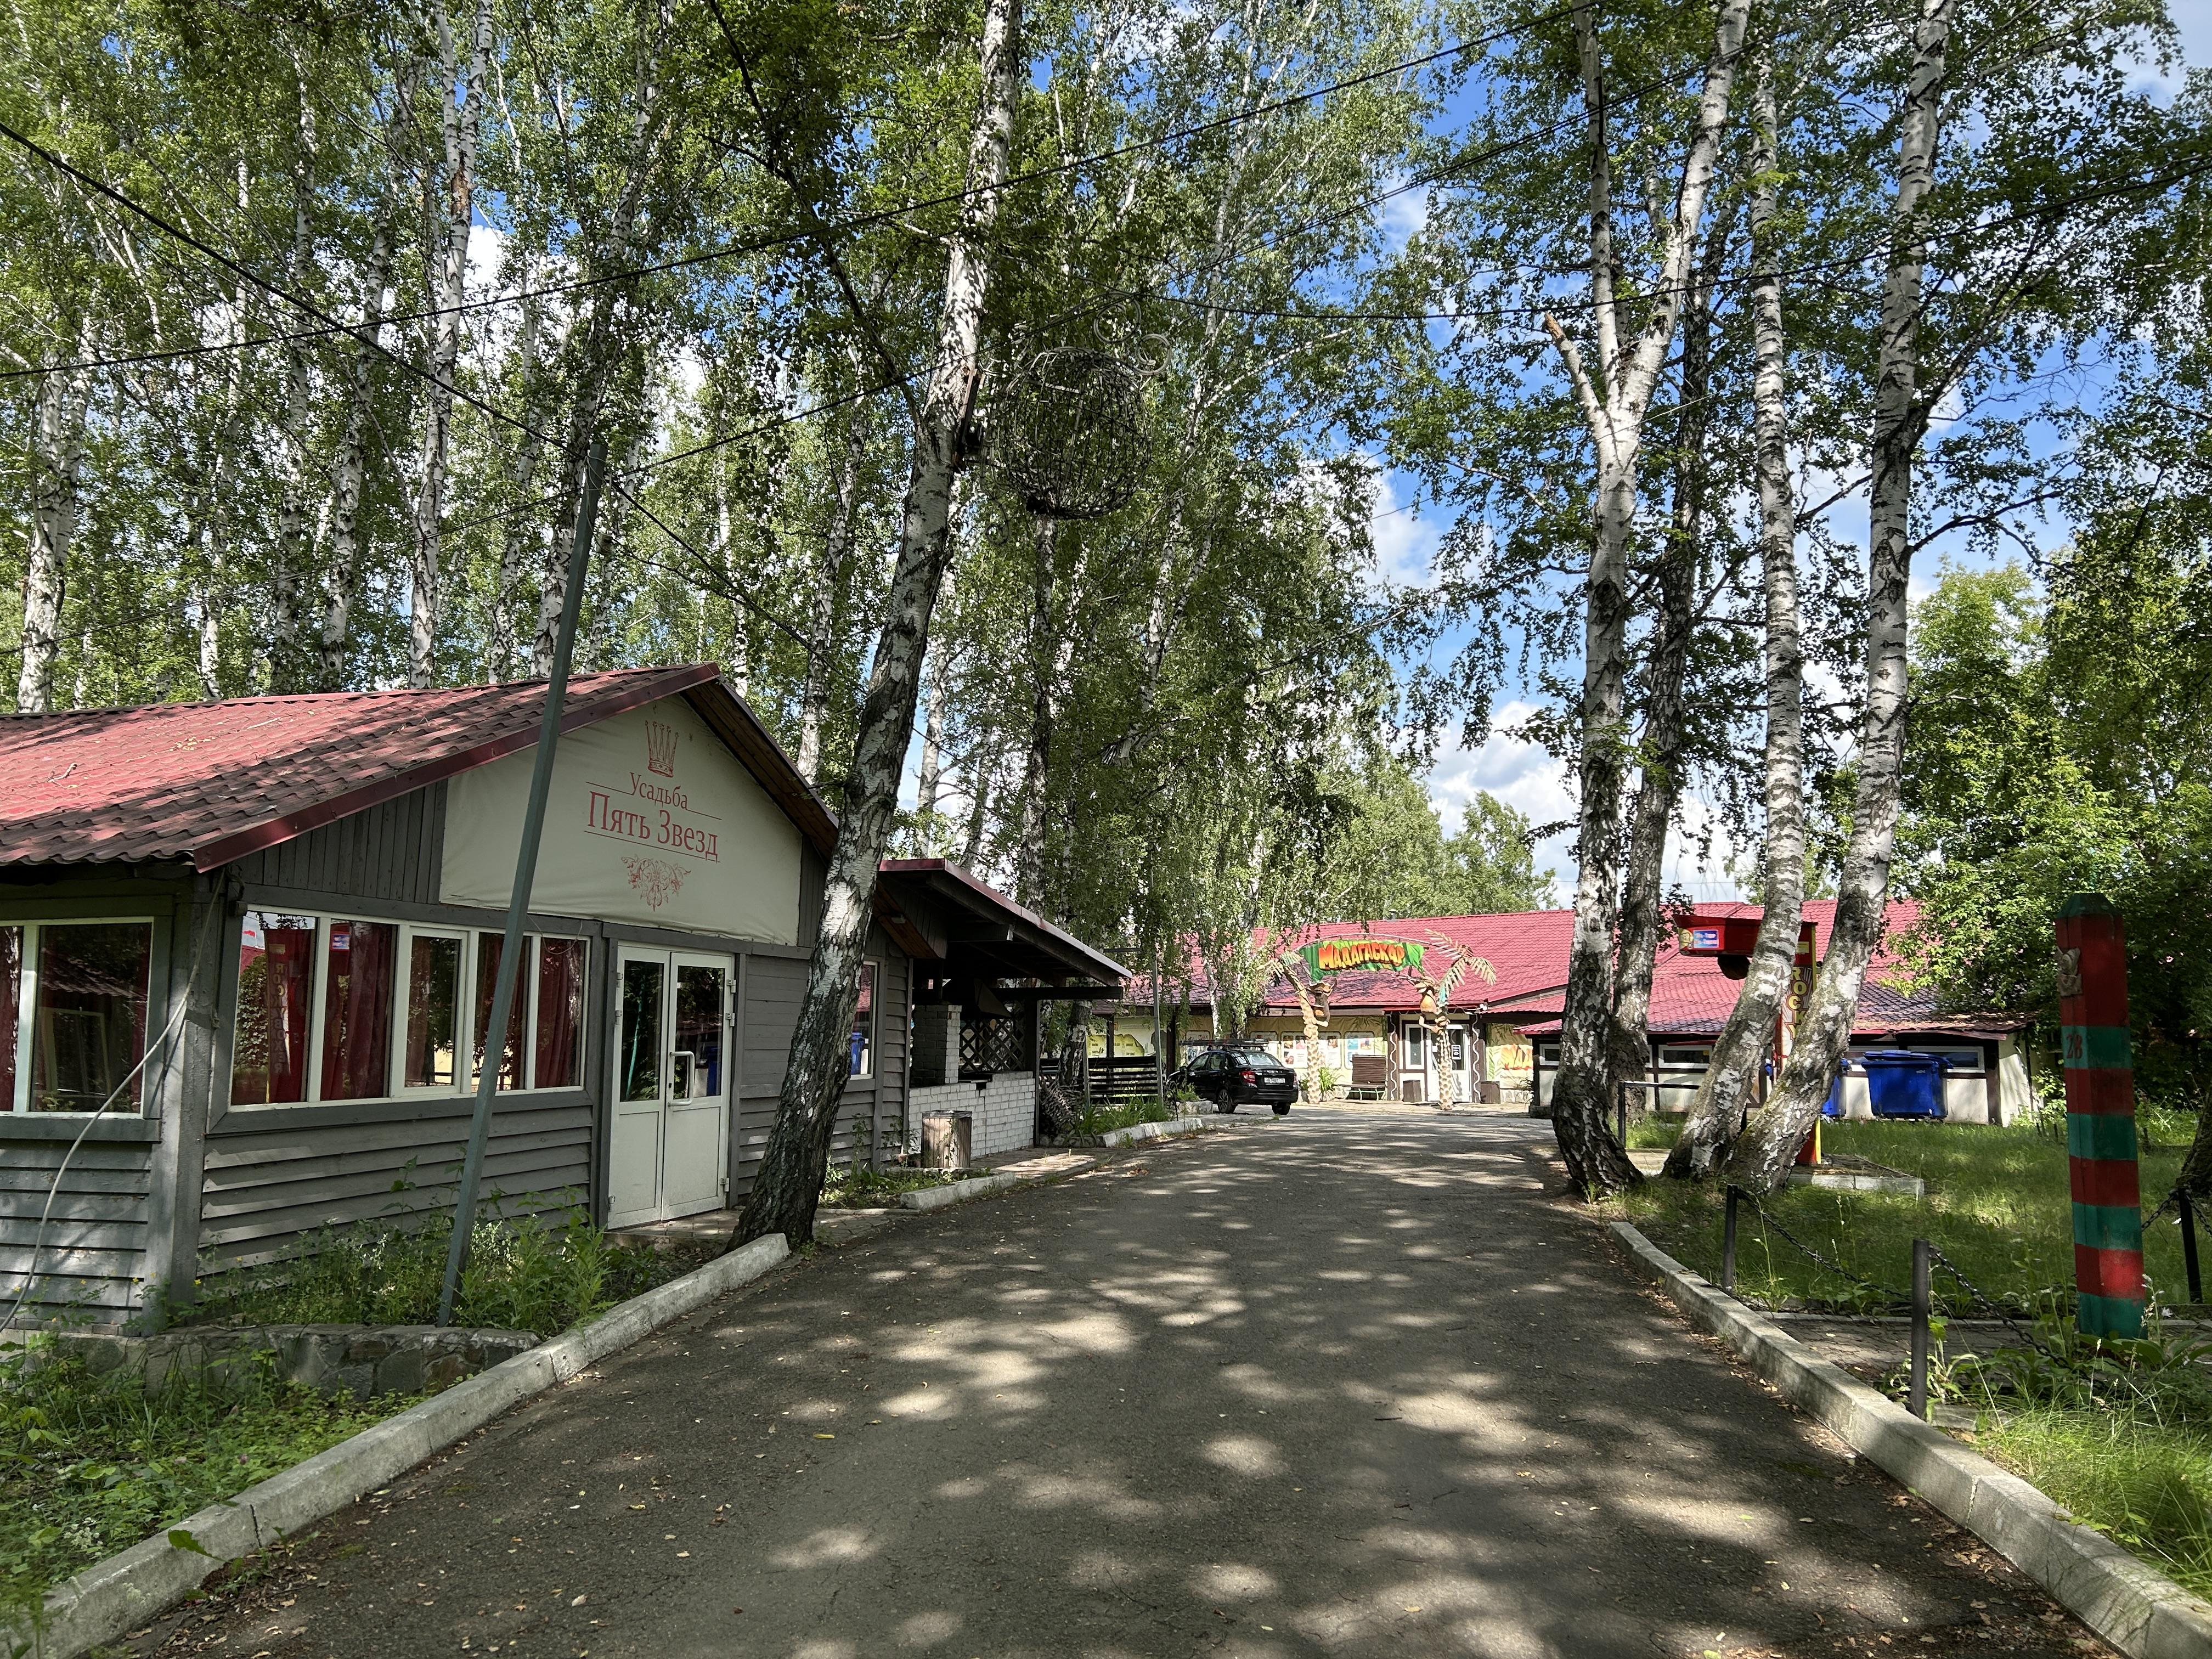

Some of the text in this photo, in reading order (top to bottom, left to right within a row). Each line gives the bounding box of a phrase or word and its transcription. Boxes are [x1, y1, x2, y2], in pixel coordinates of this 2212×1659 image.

[629, 772, 688, 810] Усадьба
[588, 791, 718, 864] Пять Звезд
